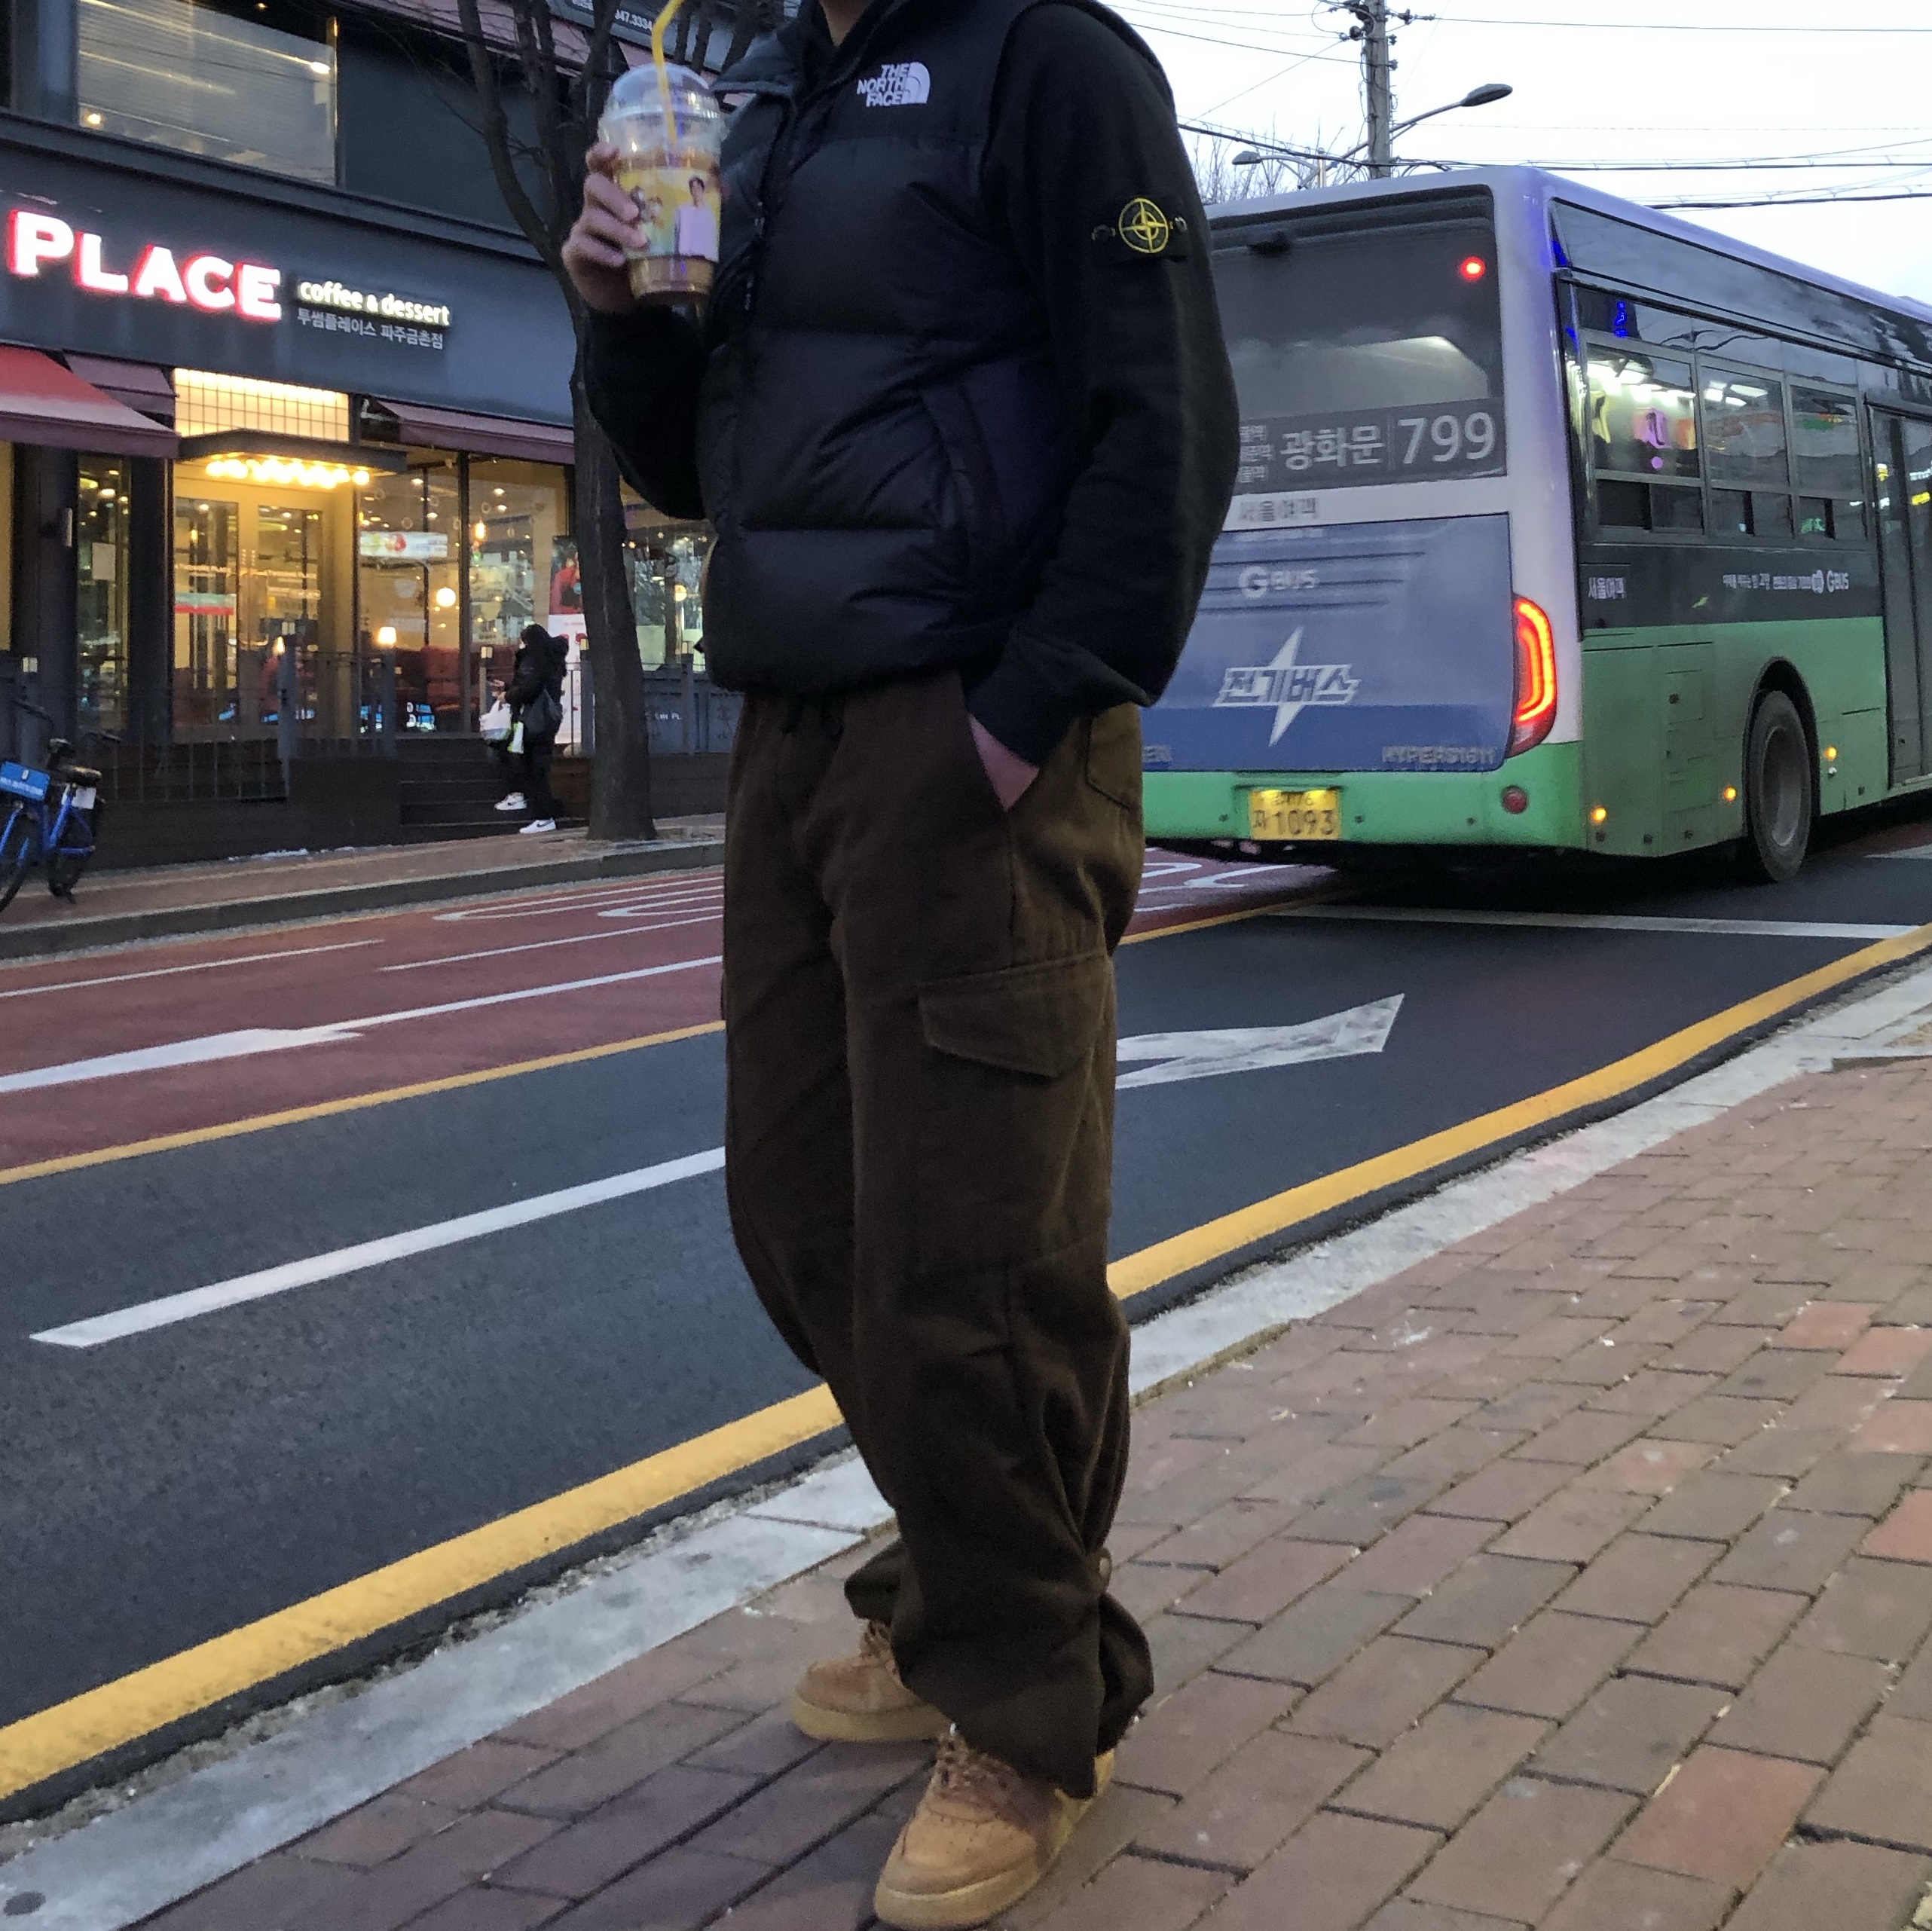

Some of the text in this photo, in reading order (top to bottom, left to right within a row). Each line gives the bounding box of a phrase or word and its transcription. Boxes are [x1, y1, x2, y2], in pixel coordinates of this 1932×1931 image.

[857, 77, 904, 95] NORTH
[881, 63, 910, 78] THE
[866, 90, 903, 107] FACE
[8, 208, 282, 322] PLACE
[298, 281, 363, 310] coffee
[381, 293, 450, 325] dessert
[298, 307, 443, 350] 투썸플레이스 파주금촌점
[1279, 412, 1496, 470] 광화문 799
